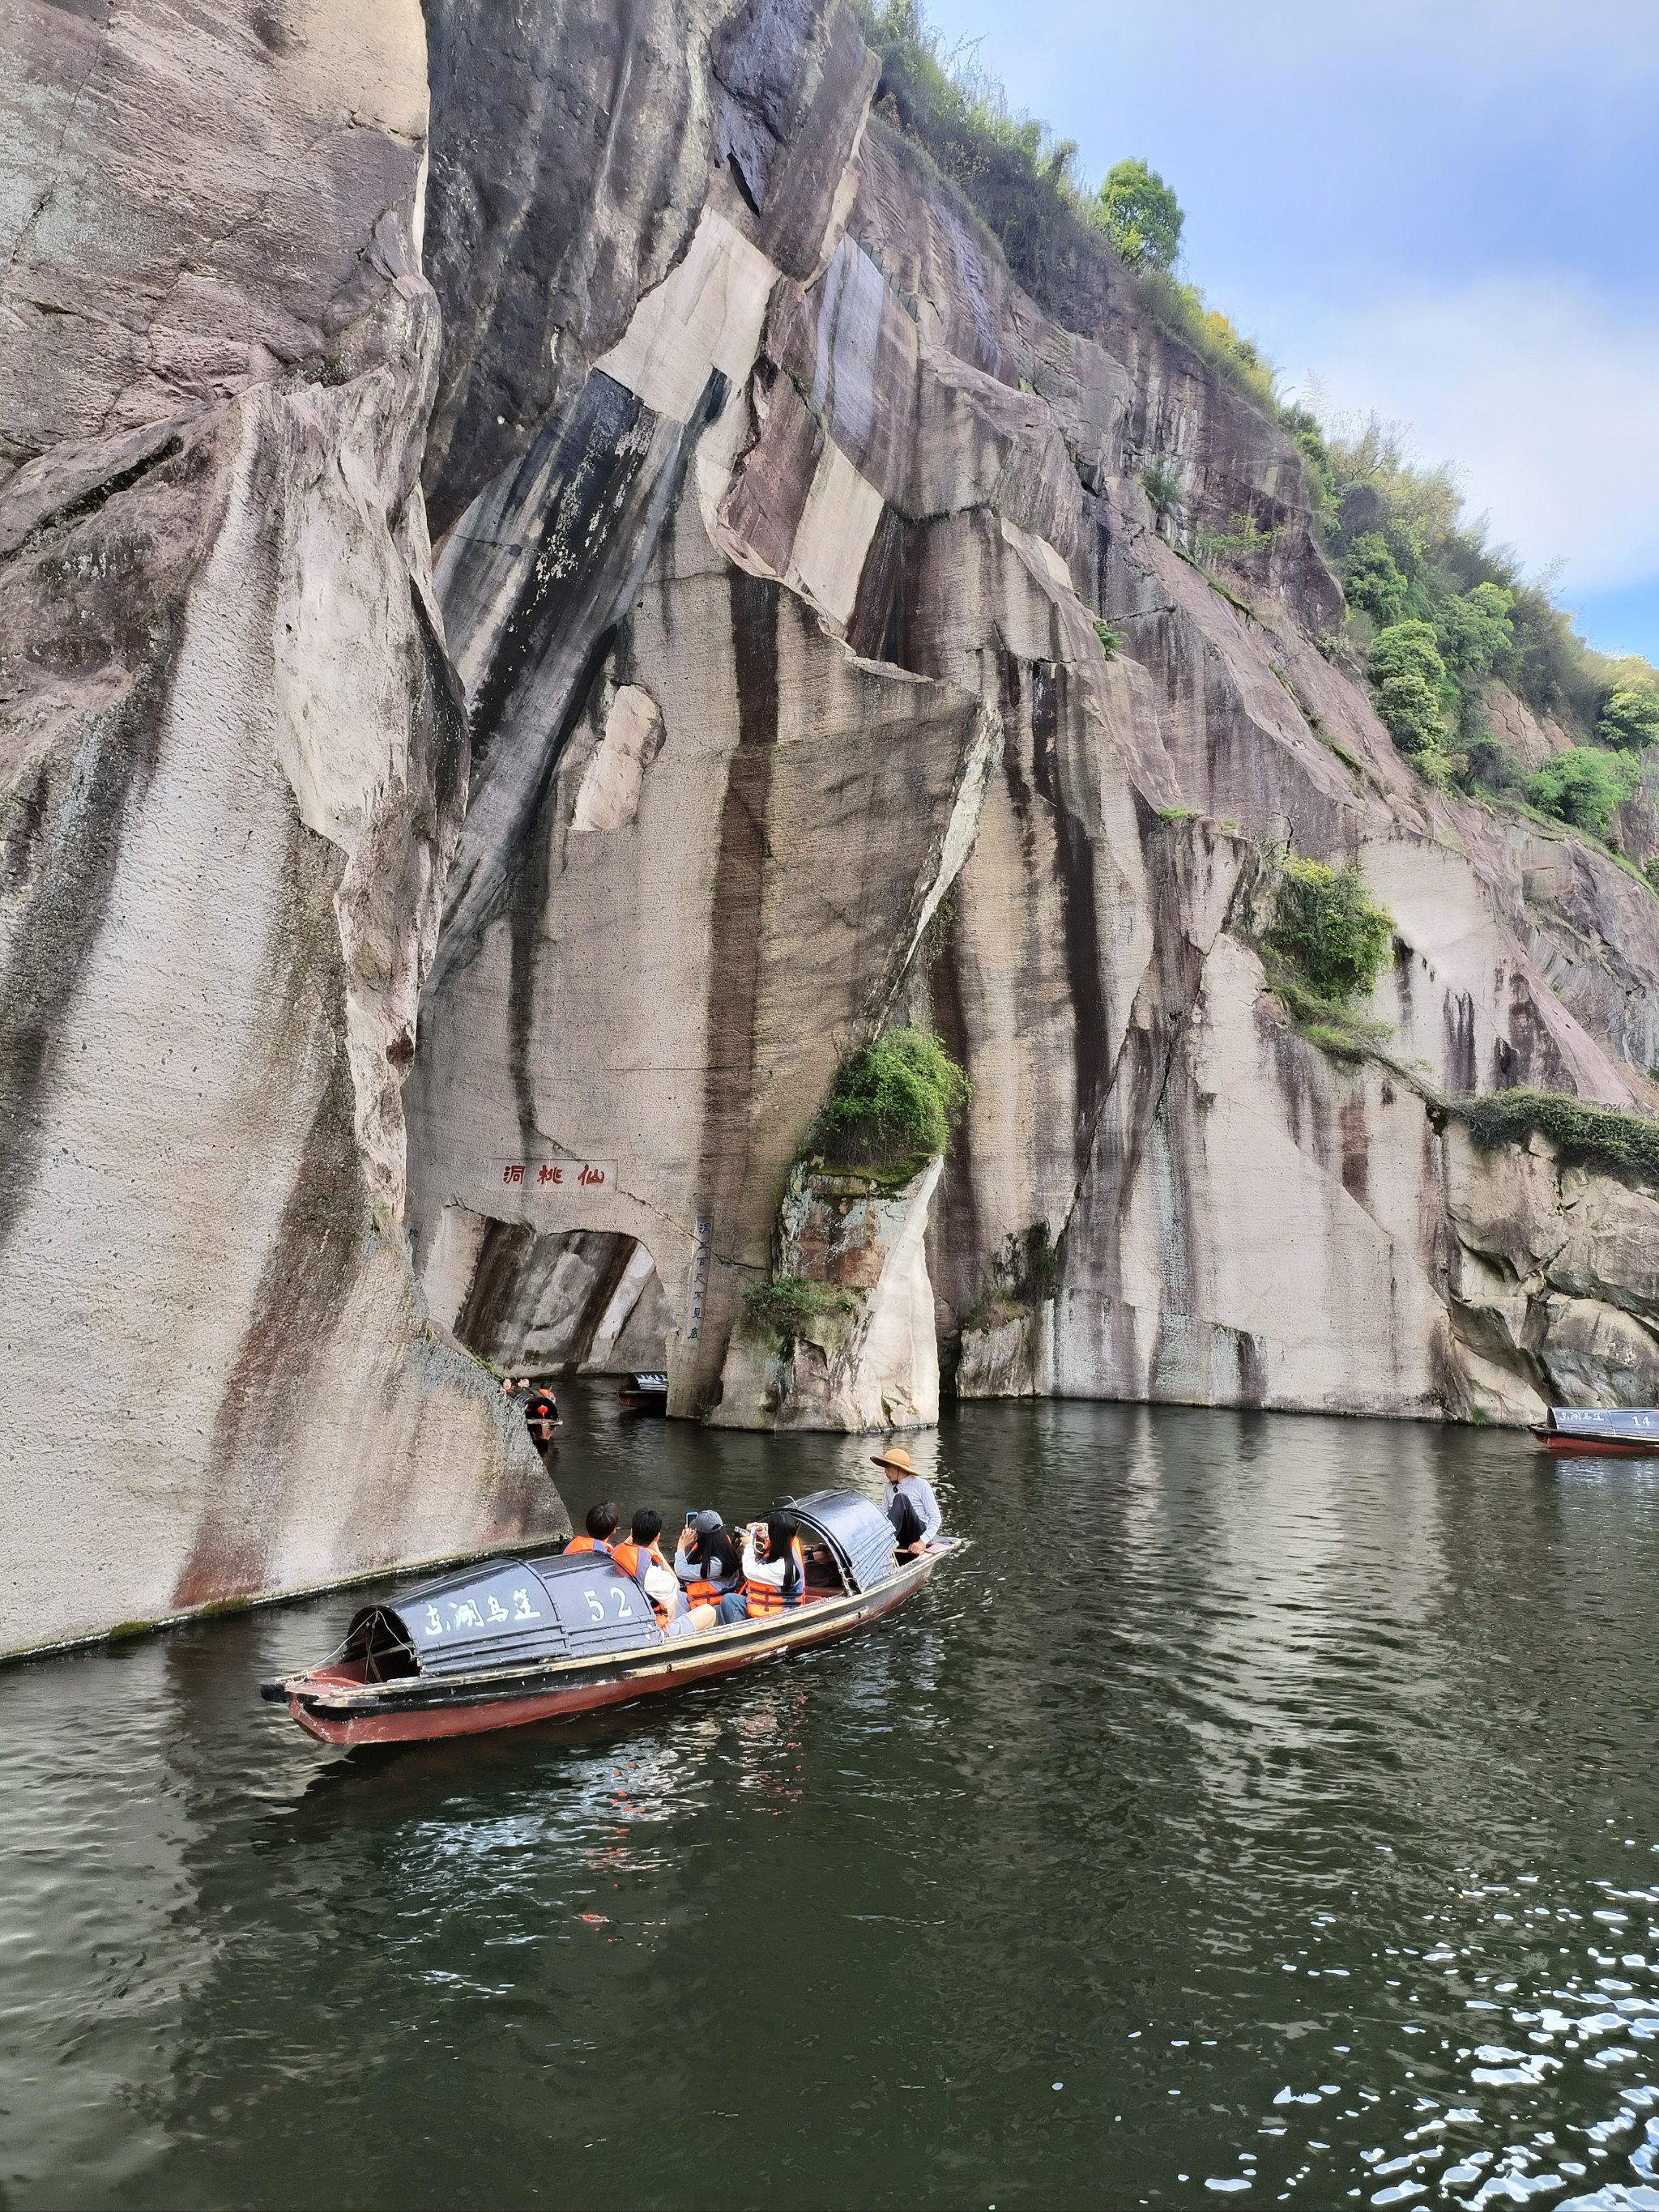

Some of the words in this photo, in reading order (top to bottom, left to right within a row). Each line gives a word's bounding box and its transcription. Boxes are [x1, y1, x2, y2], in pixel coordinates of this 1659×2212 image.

[503, 1165, 605, 1186] 仙桃洞
[1632, 1416, 1651, 1426] 14
[583, 1587, 632, 1622] 52
